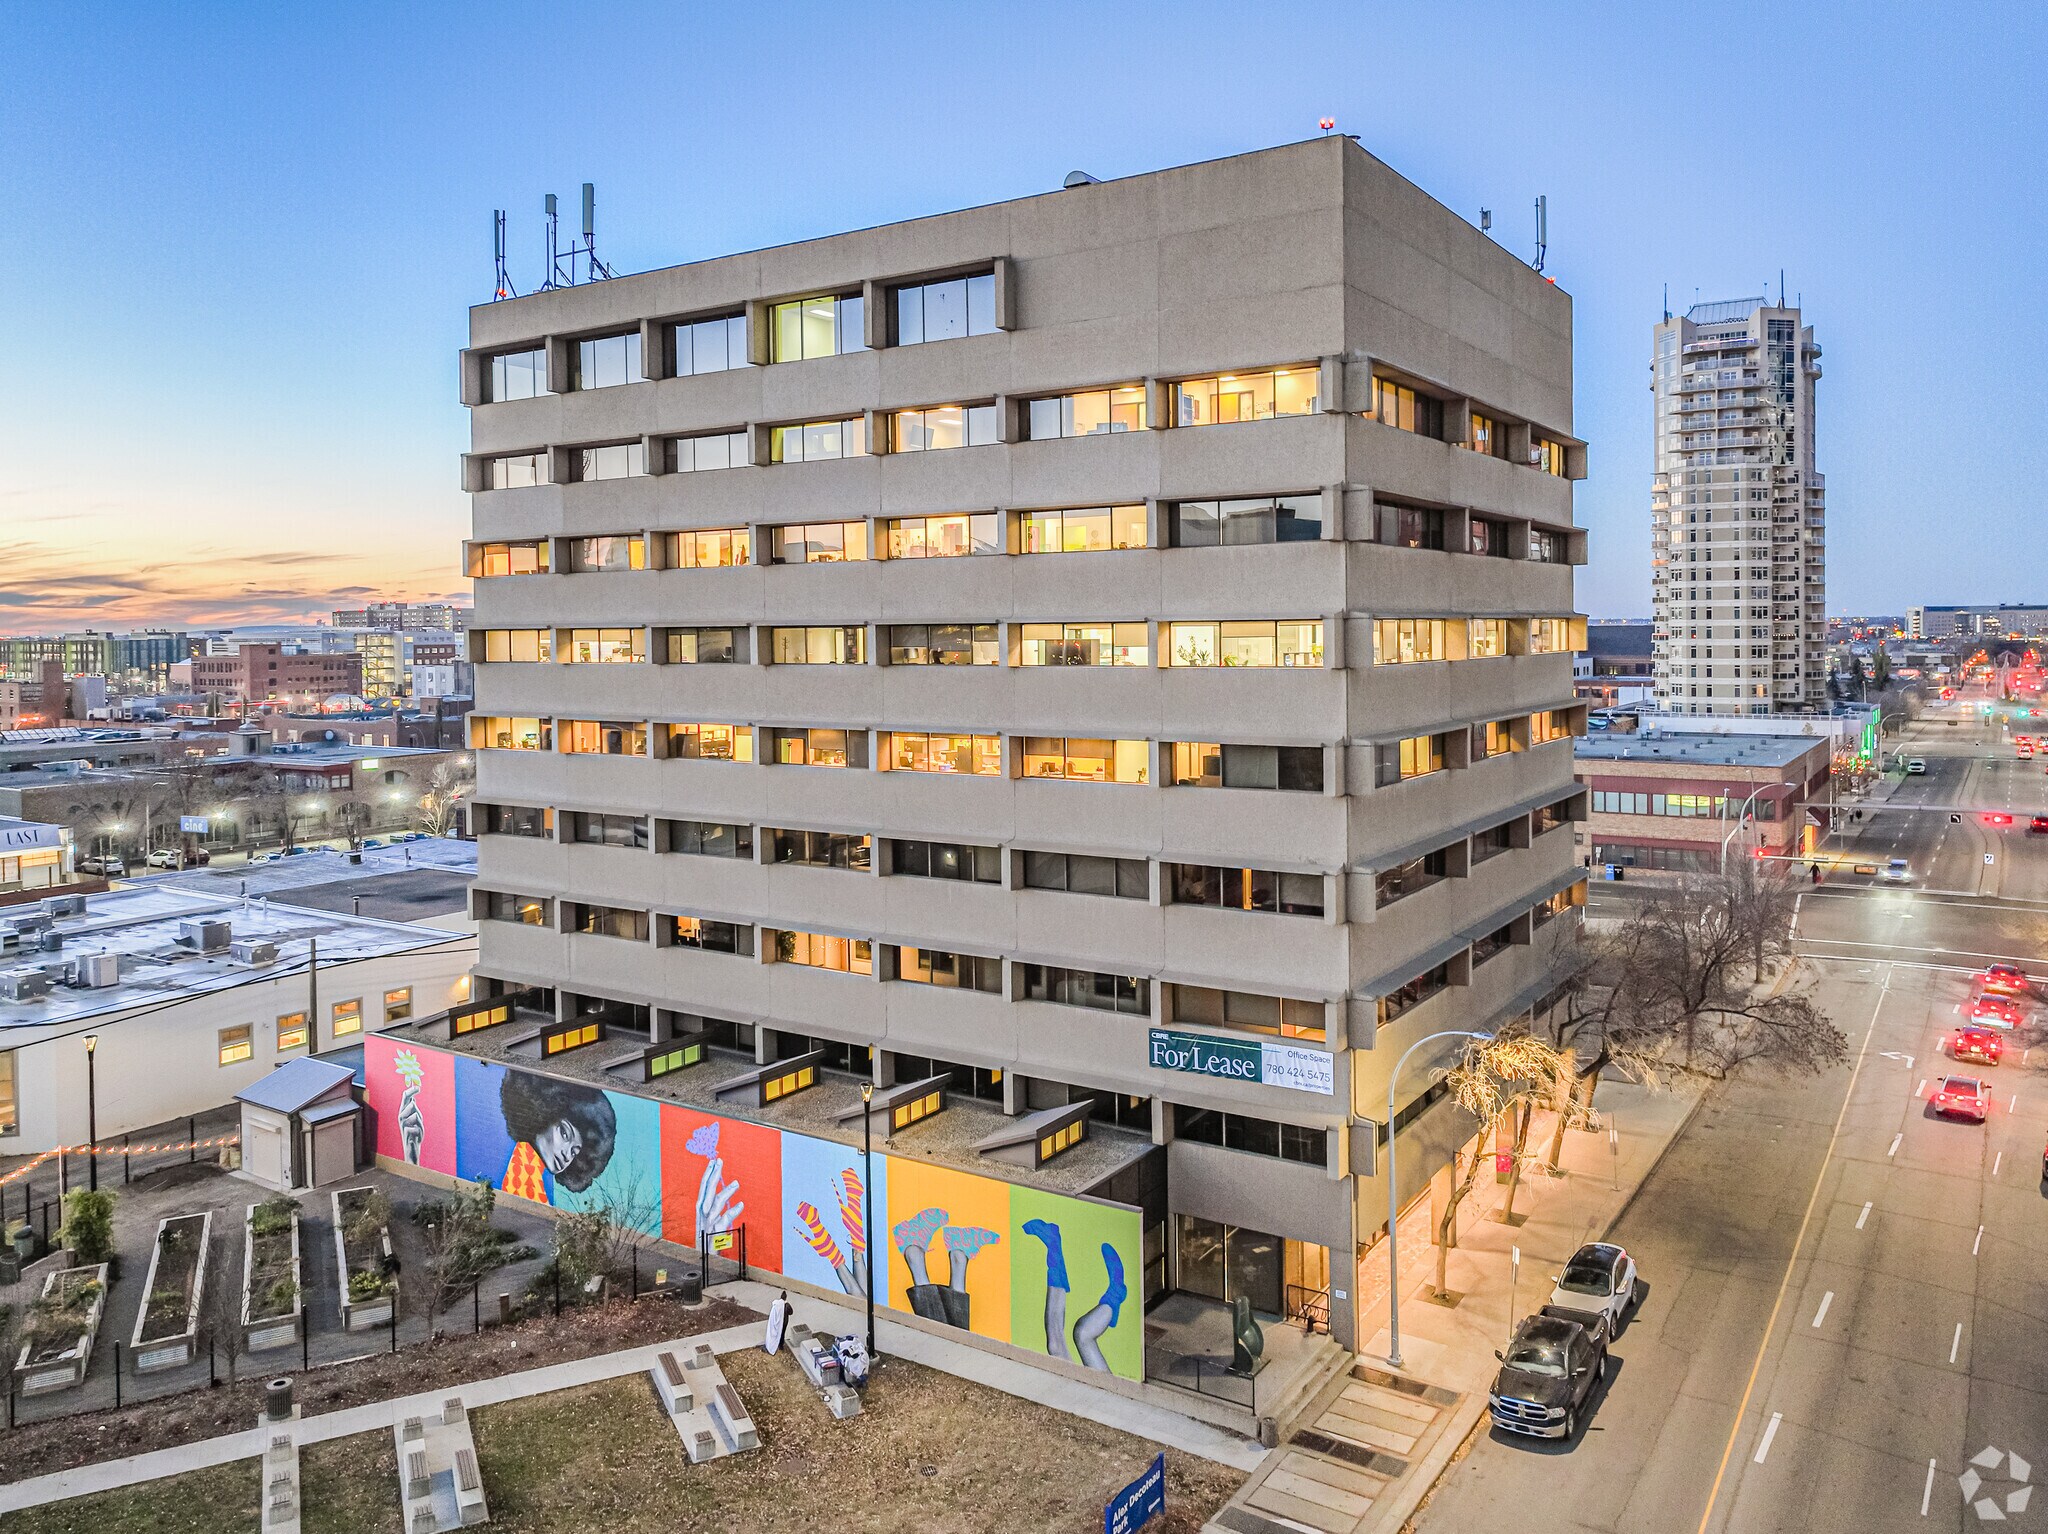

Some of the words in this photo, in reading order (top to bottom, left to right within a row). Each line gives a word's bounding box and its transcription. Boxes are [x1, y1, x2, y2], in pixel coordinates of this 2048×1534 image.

[1151, 1032, 1169, 1040] CBRE
[1151, 1041, 1189, 1069] For
[1192, 1046, 1256, 1078] Lease
[1287, 1050, 1308, 1061] Office
[1309, 1053, 1331, 1064] Space
[1266, 1063, 1285, 1075] 780
[1286, 1067, 1305, 1079] 424
[1307, 1069, 1331, 1083] 5475
[1112, 1502, 1129, 1526] Alex
[1129, 1469, 1161, 1508] Decoteau
[1112, 1515, 1129, 1534] Park
